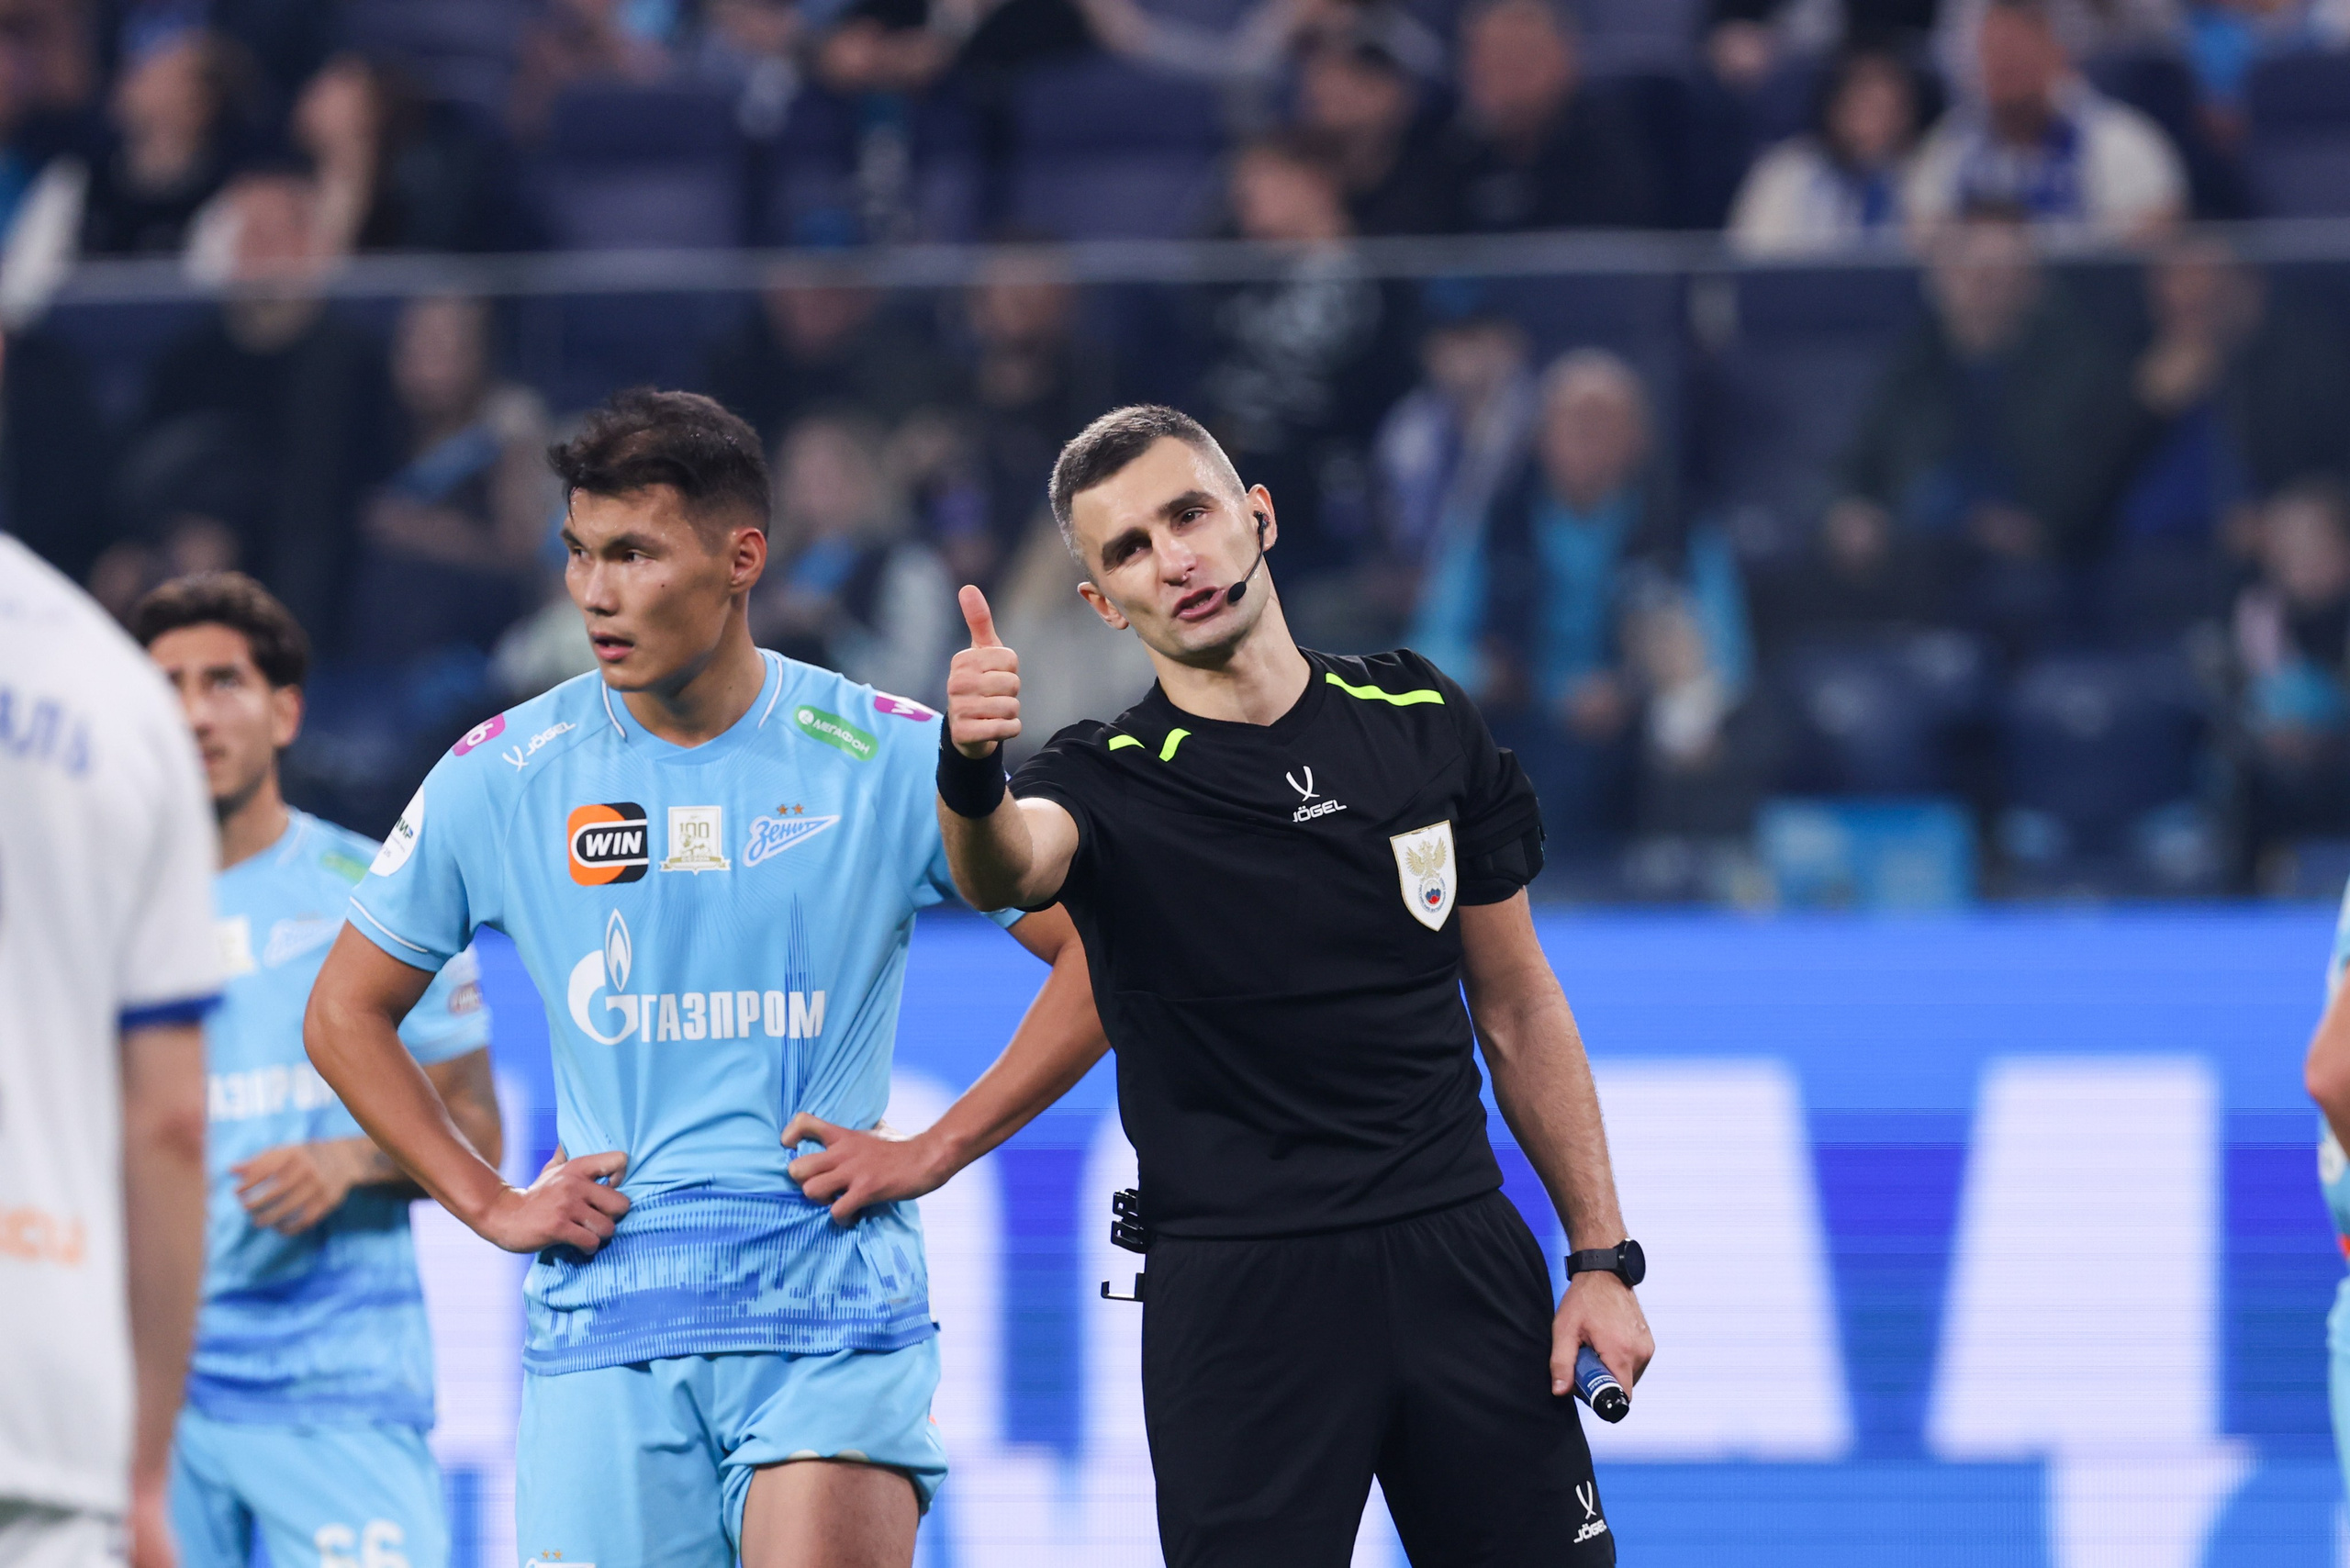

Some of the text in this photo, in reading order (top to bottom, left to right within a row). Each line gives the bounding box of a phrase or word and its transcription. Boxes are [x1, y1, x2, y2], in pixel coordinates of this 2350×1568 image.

[526, 722, 576, 756] JÖGEL
[812, 719, 870, 756] МЕГАФОН
[1292, 800, 1348, 823] JÖGEL
[586, 830, 643, 857] WIN
[641, 990, 825, 1043] ГАЗПРОМ
